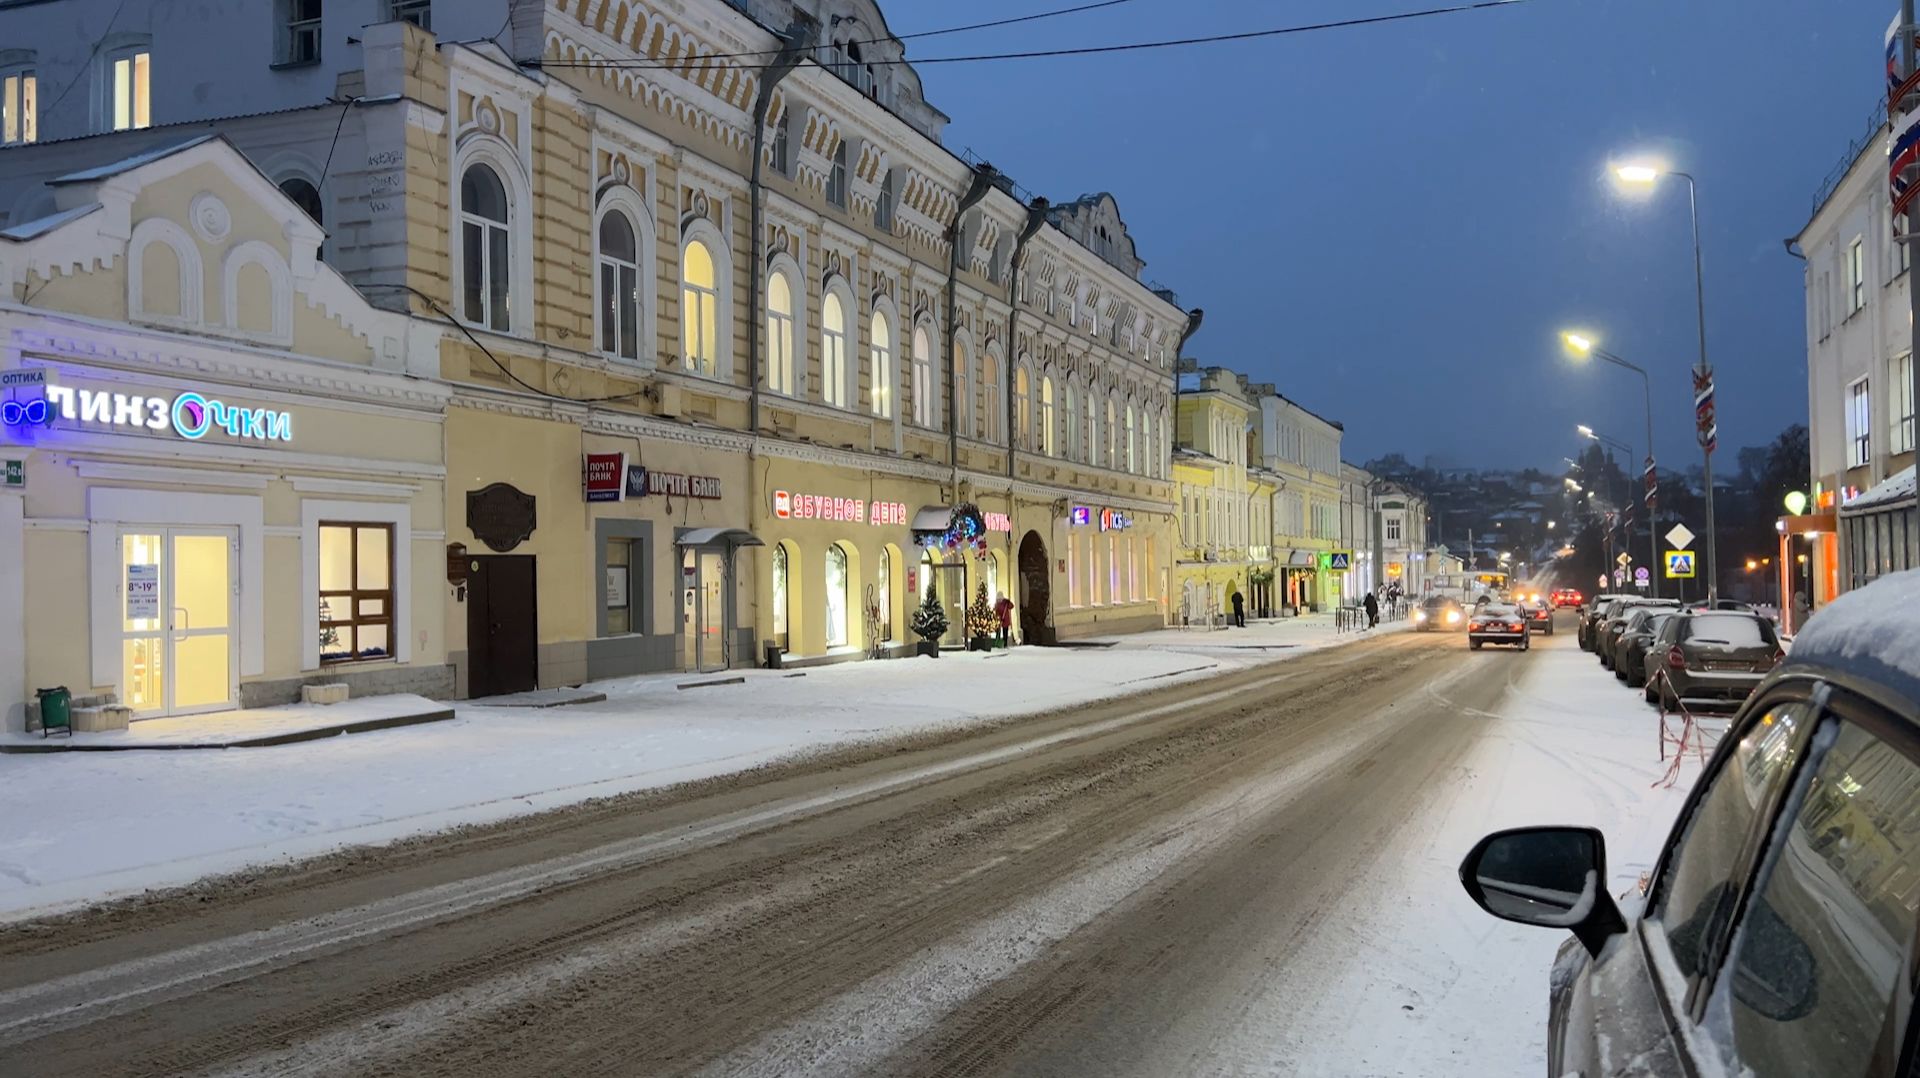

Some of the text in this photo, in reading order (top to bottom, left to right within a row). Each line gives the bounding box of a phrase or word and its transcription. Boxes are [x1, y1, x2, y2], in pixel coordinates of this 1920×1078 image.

[2, 372, 44, 384] ОПТИКА
[589, 462, 616, 471] ПОЧТА
[589, 472, 612, 481] БАНК
[649, 472, 690, 496] ПОЧТА
[793, 493, 864, 522] ОБУВНОЕ
[871, 500, 907, 526] ДЕПО
[985, 511, 1011, 532] ОБУВЬ
